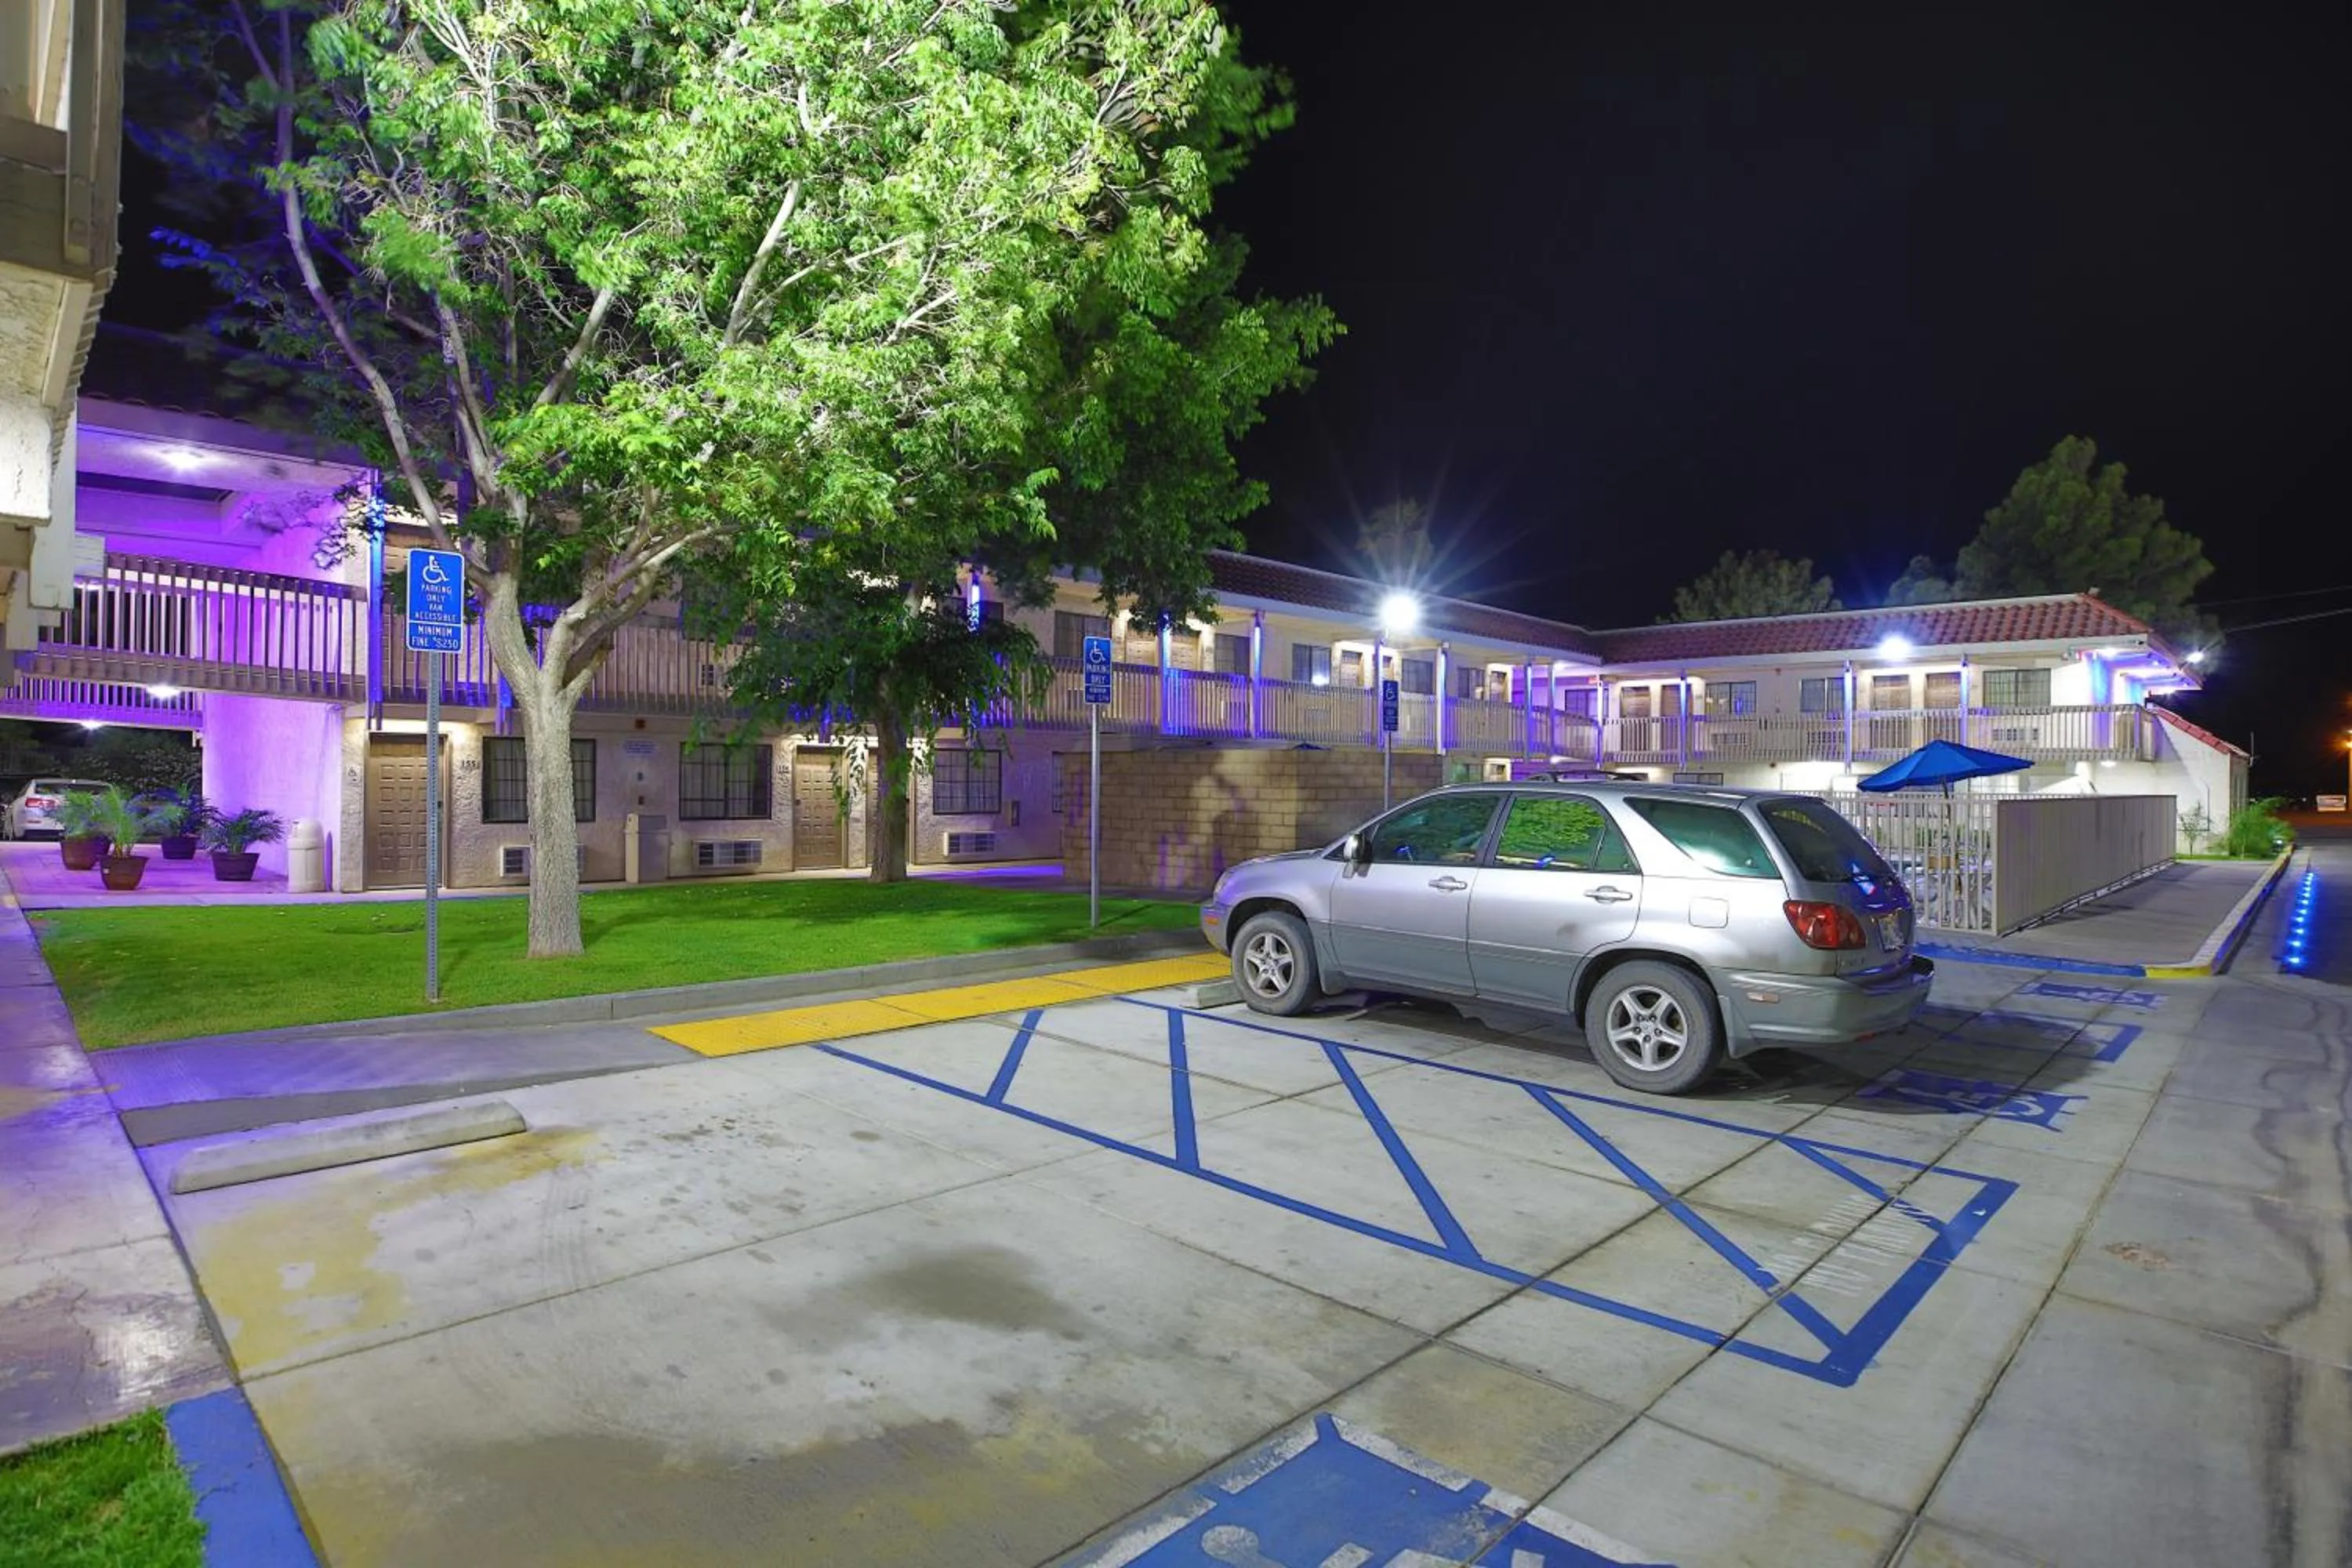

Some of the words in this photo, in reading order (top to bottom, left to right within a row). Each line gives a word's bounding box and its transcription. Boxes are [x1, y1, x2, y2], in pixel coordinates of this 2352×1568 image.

[421, 583, 452, 594] PARKING
[426, 593, 445, 602] ONLY
[418, 625, 452, 637] MINIMUM
[412, 636, 428, 647] FINE
[432, 637, 459, 649] $250
